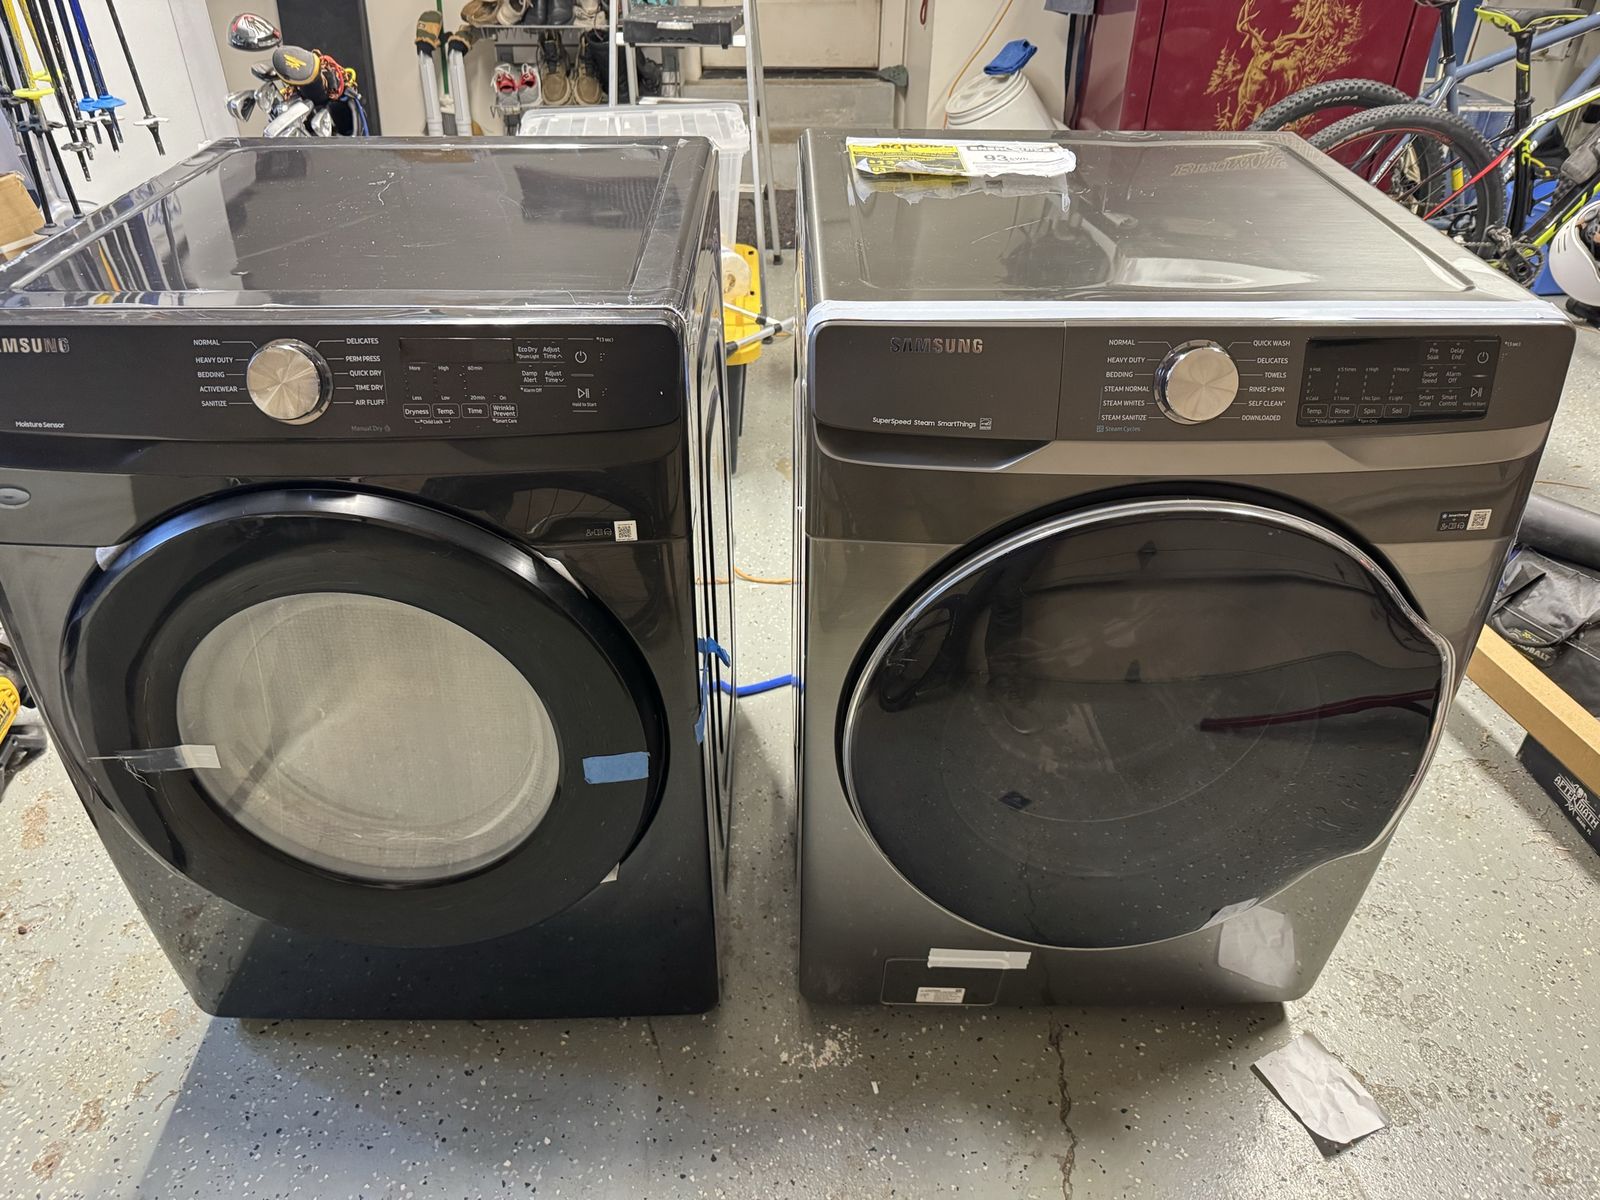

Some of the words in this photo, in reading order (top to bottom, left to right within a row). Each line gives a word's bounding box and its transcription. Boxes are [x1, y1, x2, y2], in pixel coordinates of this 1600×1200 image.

[0, 337, 70, 353] MSUNG
[890, 337, 983, 353] SAMSUNG
[405, 408, 429, 416] Dryness
[438, 408, 455, 416] Temp.
[872, 416, 912, 426] SuperSpeed
[937, 420, 976, 429] SmartThings
